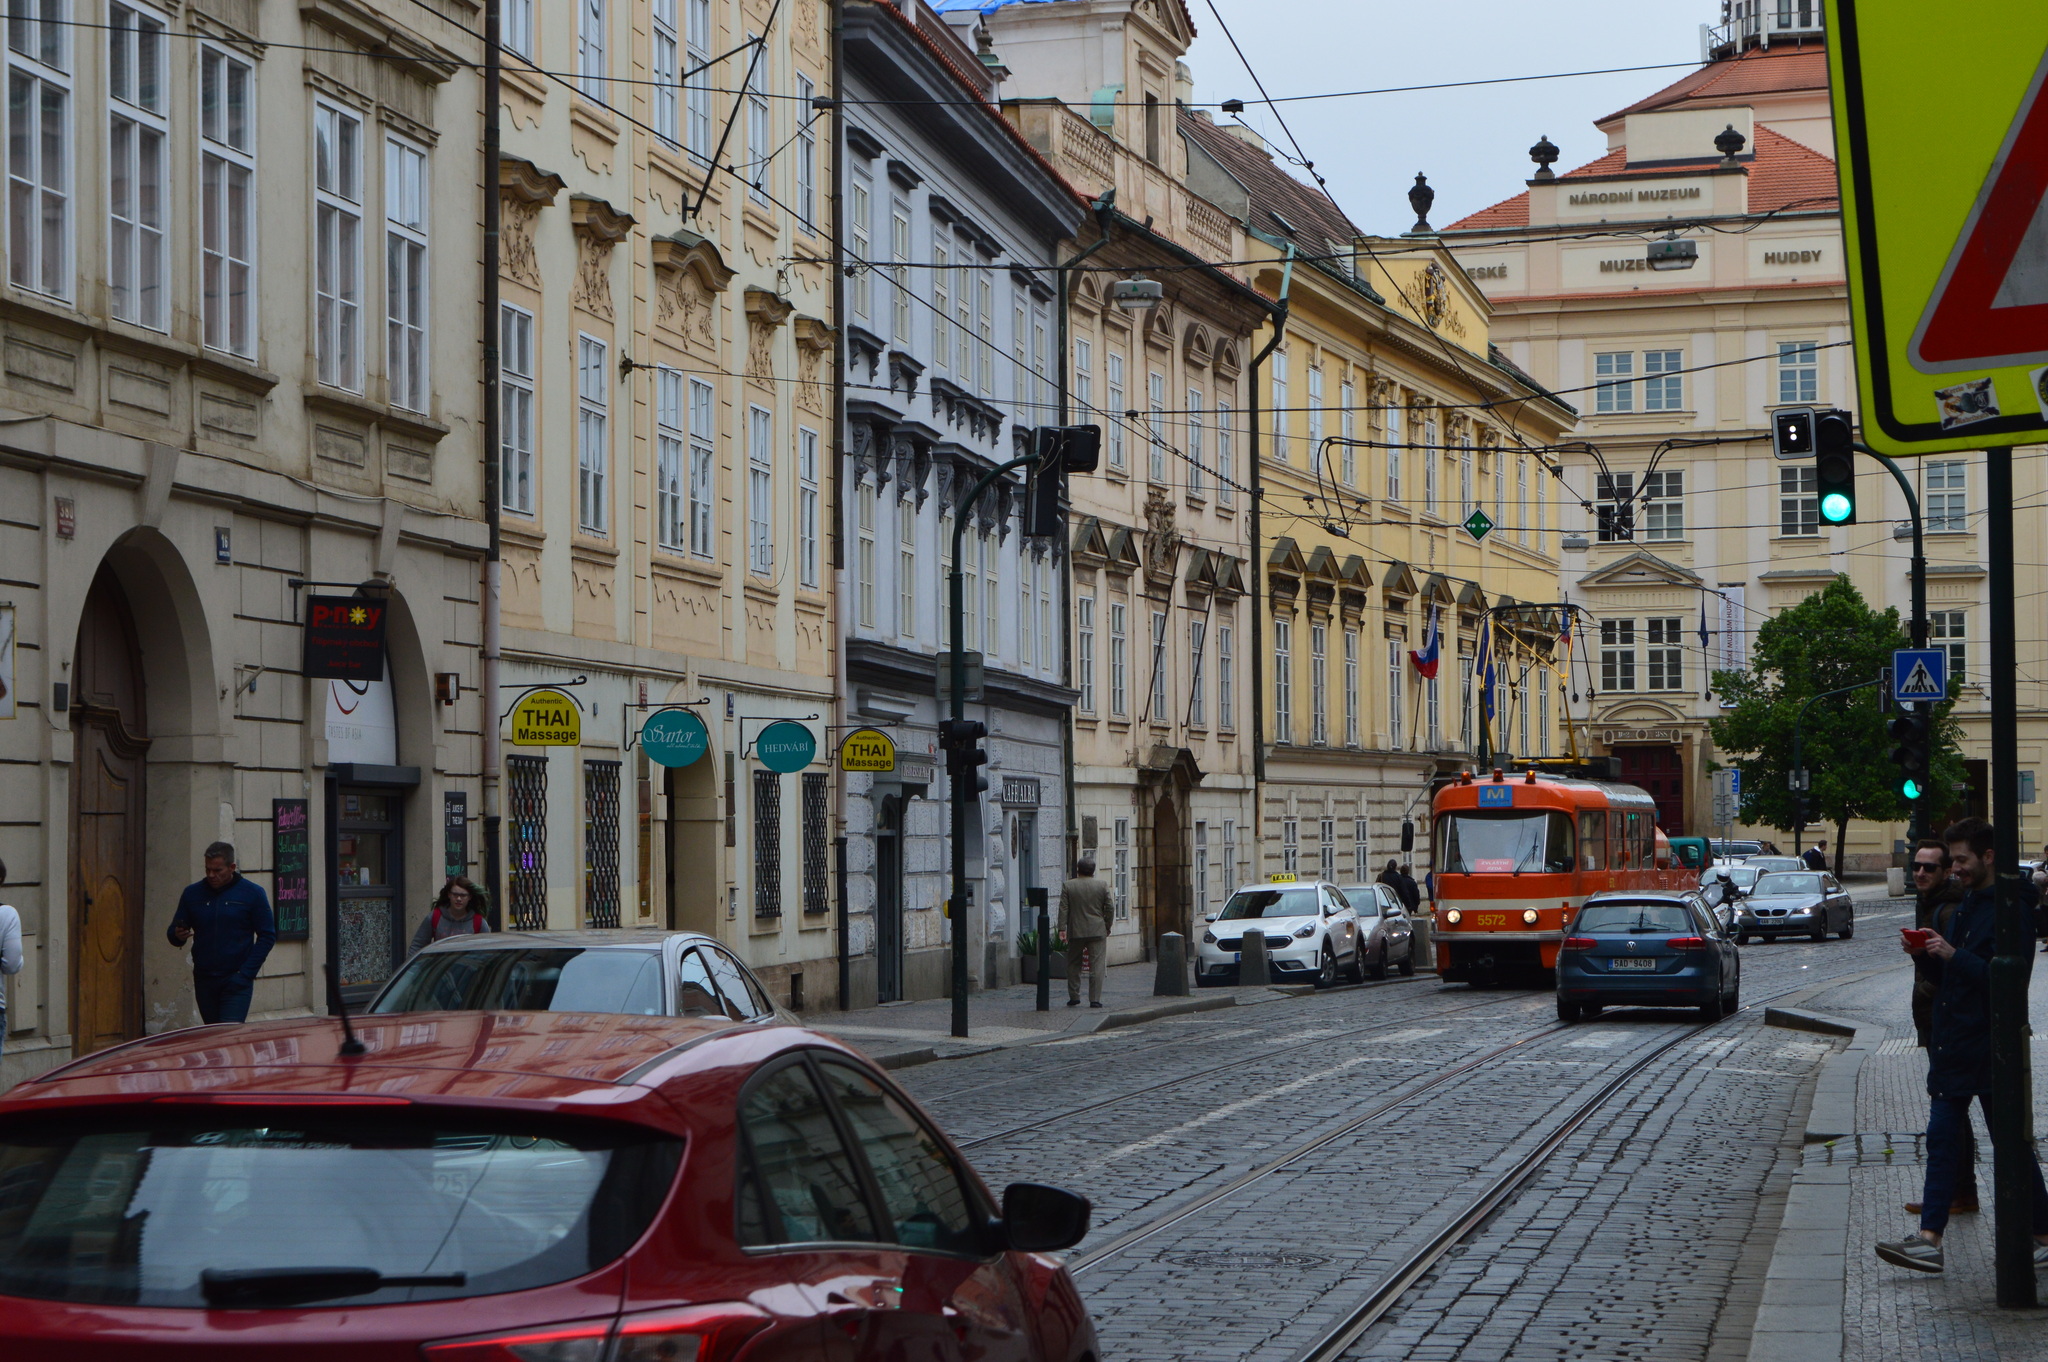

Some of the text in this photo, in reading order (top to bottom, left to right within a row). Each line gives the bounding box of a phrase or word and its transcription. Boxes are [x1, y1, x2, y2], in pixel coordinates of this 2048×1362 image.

[1569, 187, 1700, 205] NÁRODNÍ MUZEUM
[1466, 262, 1508, 280] ESKÉ
[1764, 249, 1822, 265] HUDBY
[221, 534, 229, 549] 16
[523, 709, 570, 726] THAI
[518, 728, 577, 743] Massage
[643, 724, 697, 744] Sartor
[765, 741, 808, 753] HEDVÁBÍ
[850, 744, 886, 756] THAI
[846, 758, 892, 769] Massage
[1003, 779, 1036, 802] CAFÉ ALBA
[1487, 787, 1504, 799] M
[1478, 914, 1506, 926] 5572
[1614, 959, 1652, 967] 5AD 9408
